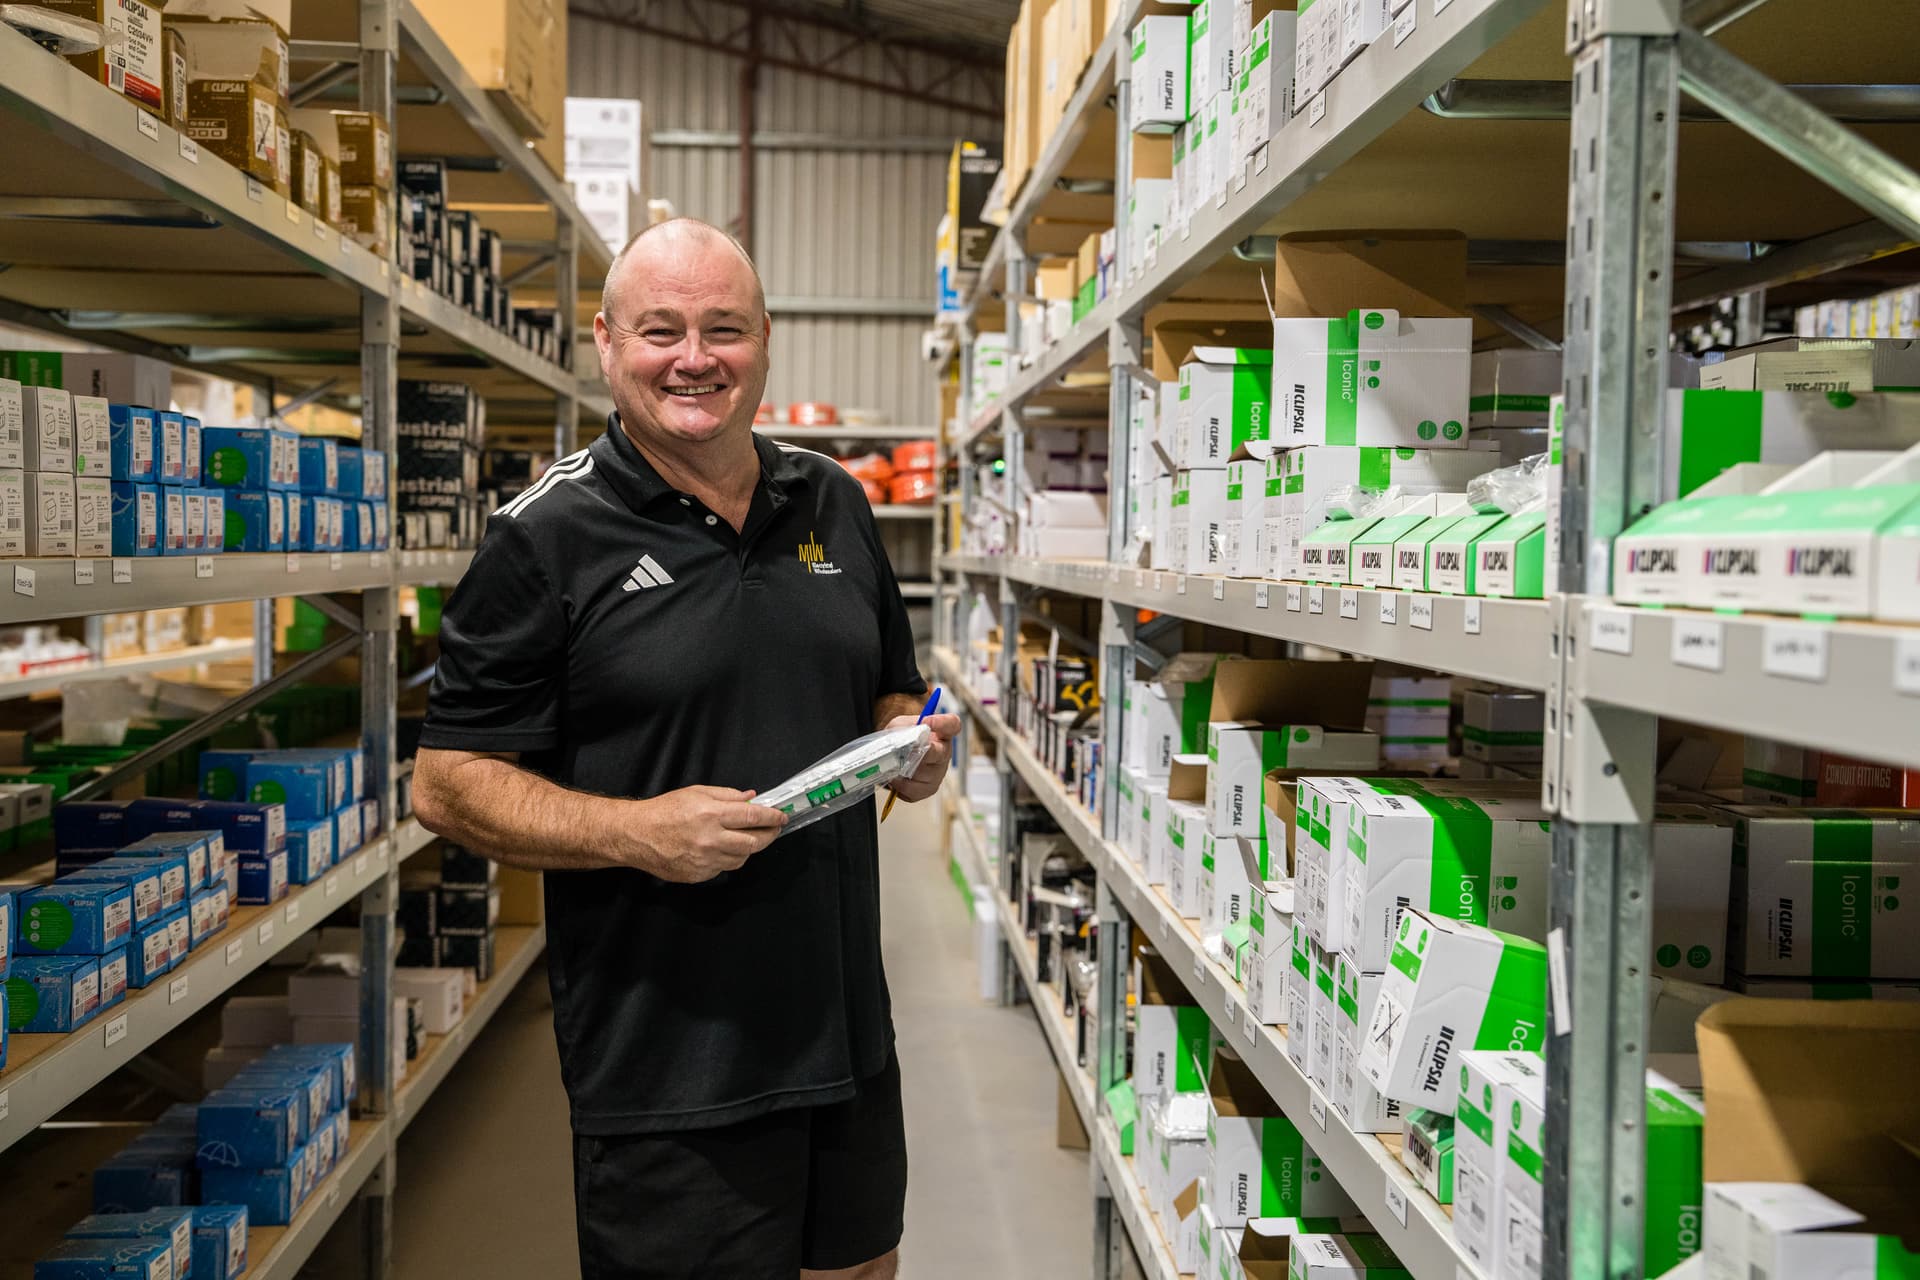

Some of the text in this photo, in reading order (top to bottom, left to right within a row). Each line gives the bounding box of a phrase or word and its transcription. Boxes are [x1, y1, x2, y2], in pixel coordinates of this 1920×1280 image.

[124, 0, 149, 21] CLIPSAL
[211, 82, 246, 94] CLIPSAL
[1165, 79, 1173, 111] CLIPSAL
[1341, 360, 1355, 400] Iconic
[1293, 395, 1305, 434] CLIPSAL
[399, 421, 466, 438] ustrial
[1209, 425, 1219, 458] CLIPSAL
[399, 477, 462, 494] ustrial
[1305, 549, 1322, 564] CLIPSAL
[1329, 549, 1346, 565] CLIPSAL
[1364, 552, 1382, 569] CLIPSAL
[1401, 550, 1420, 569] CLIPSAL
[1439, 551, 1460, 571] CLIPSAL
[1486, 551, 1508, 572] CLIPSAL
[1636, 549, 1678, 573] CLIPSAL
[1711, 549, 1758, 575] CLIPSAL
[1797, 549, 1854, 576] CLIPSAL
[1825, 764, 1892, 789] CONDUIT FITTINGS
[1232, 792, 1243, 827] CLIPSAL
[1458, 874, 1479, 923] Iconi
[1841, 875, 1861, 936] Iconic
[1229, 902, 1240, 925] CLIP
[1779, 910, 1793, 961] CLIPSAL
[1507, 1019, 1536, 1052] Ico
[1424, 1035, 1451, 1093] CLIPSAL
[1281, 1157, 1295, 1201] Iconic
[1237, 1181, 1248, 1216] CLIPSAL
[1677, 1205, 1703, 1262] Icon
